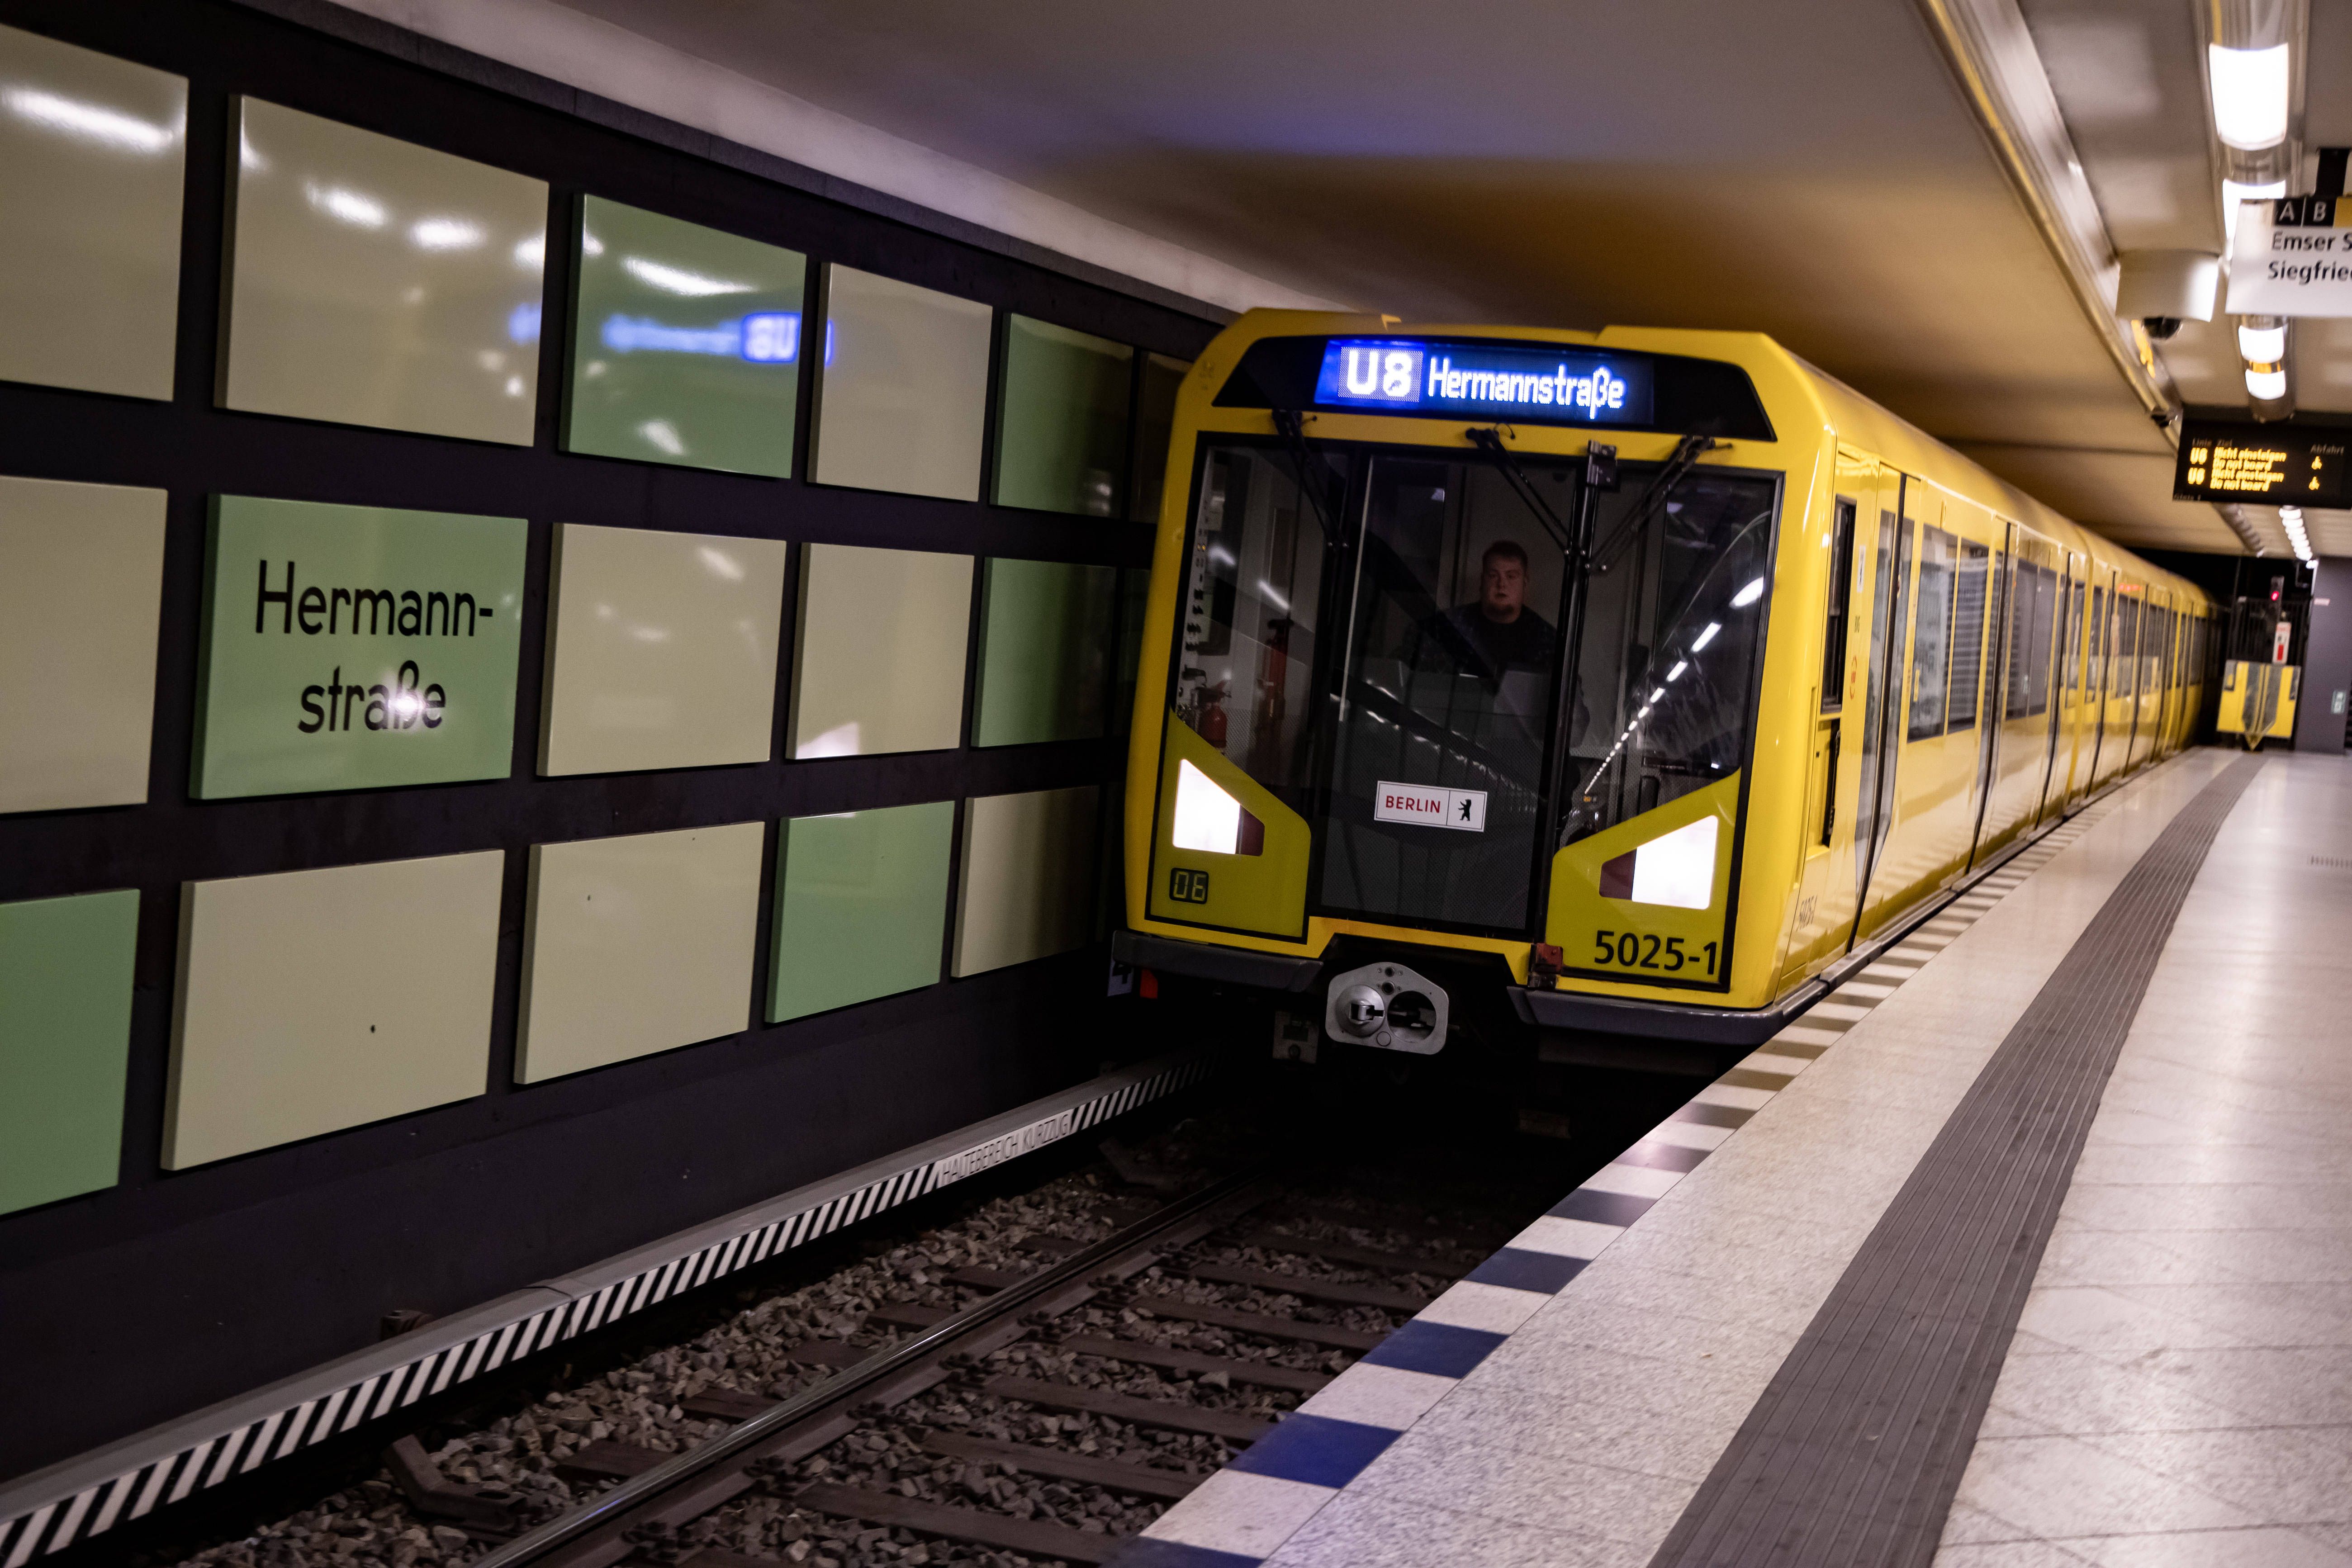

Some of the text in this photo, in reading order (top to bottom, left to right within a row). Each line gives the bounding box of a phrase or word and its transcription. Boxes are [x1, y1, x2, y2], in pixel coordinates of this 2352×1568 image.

[2279, 201, 2327, 222] A B
[2272, 231, 2336, 251] Emser
[2268, 260, 2352, 285] Siegfrie
[1347, 349, 1412, 396] U8
[1428, 357, 1625, 420] Hermannstraße
[256, 559, 493, 637] Hermann-
[298, 660, 446, 734] straße
[1385, 795, 1441, 813] BERLIN
[1593, 930, 1718, 975] 5025-1
